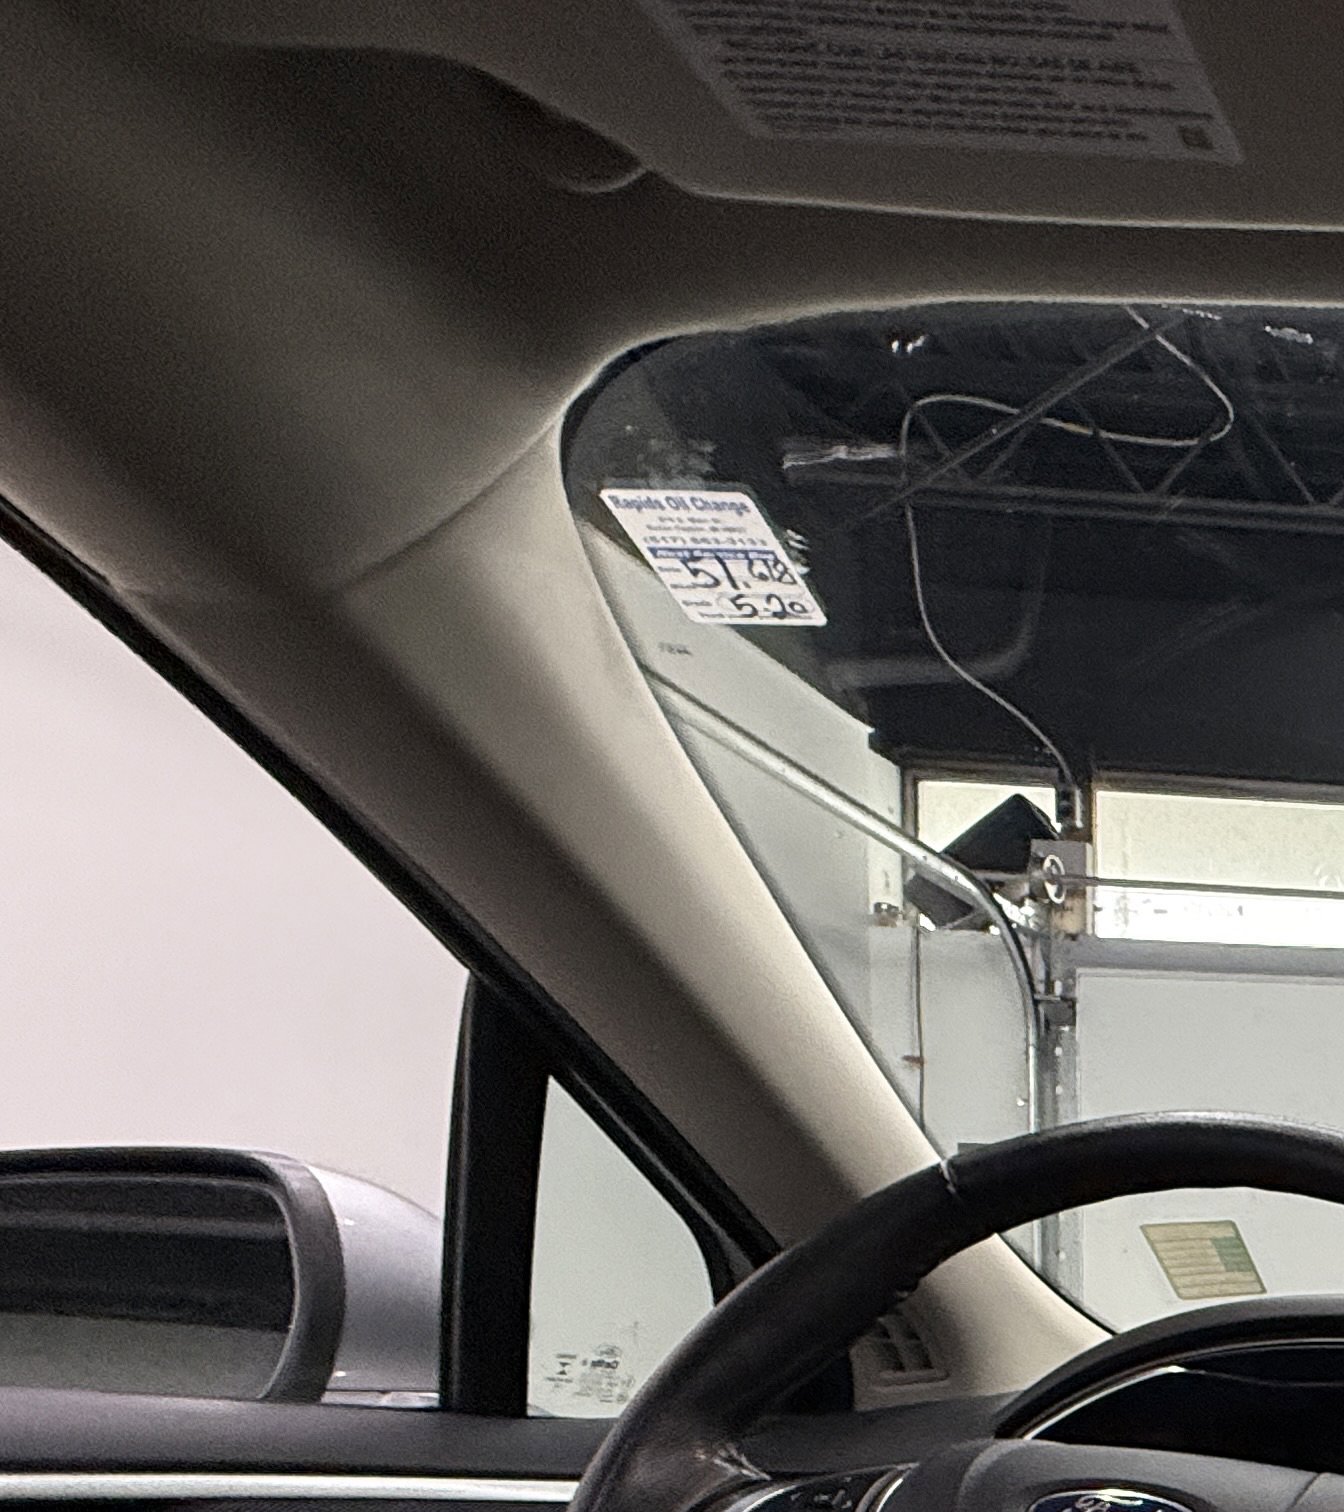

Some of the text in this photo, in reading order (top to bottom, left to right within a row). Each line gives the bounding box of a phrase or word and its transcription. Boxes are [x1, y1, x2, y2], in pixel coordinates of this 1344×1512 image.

[608, 495, 751, 516] Rapids Oil Change
